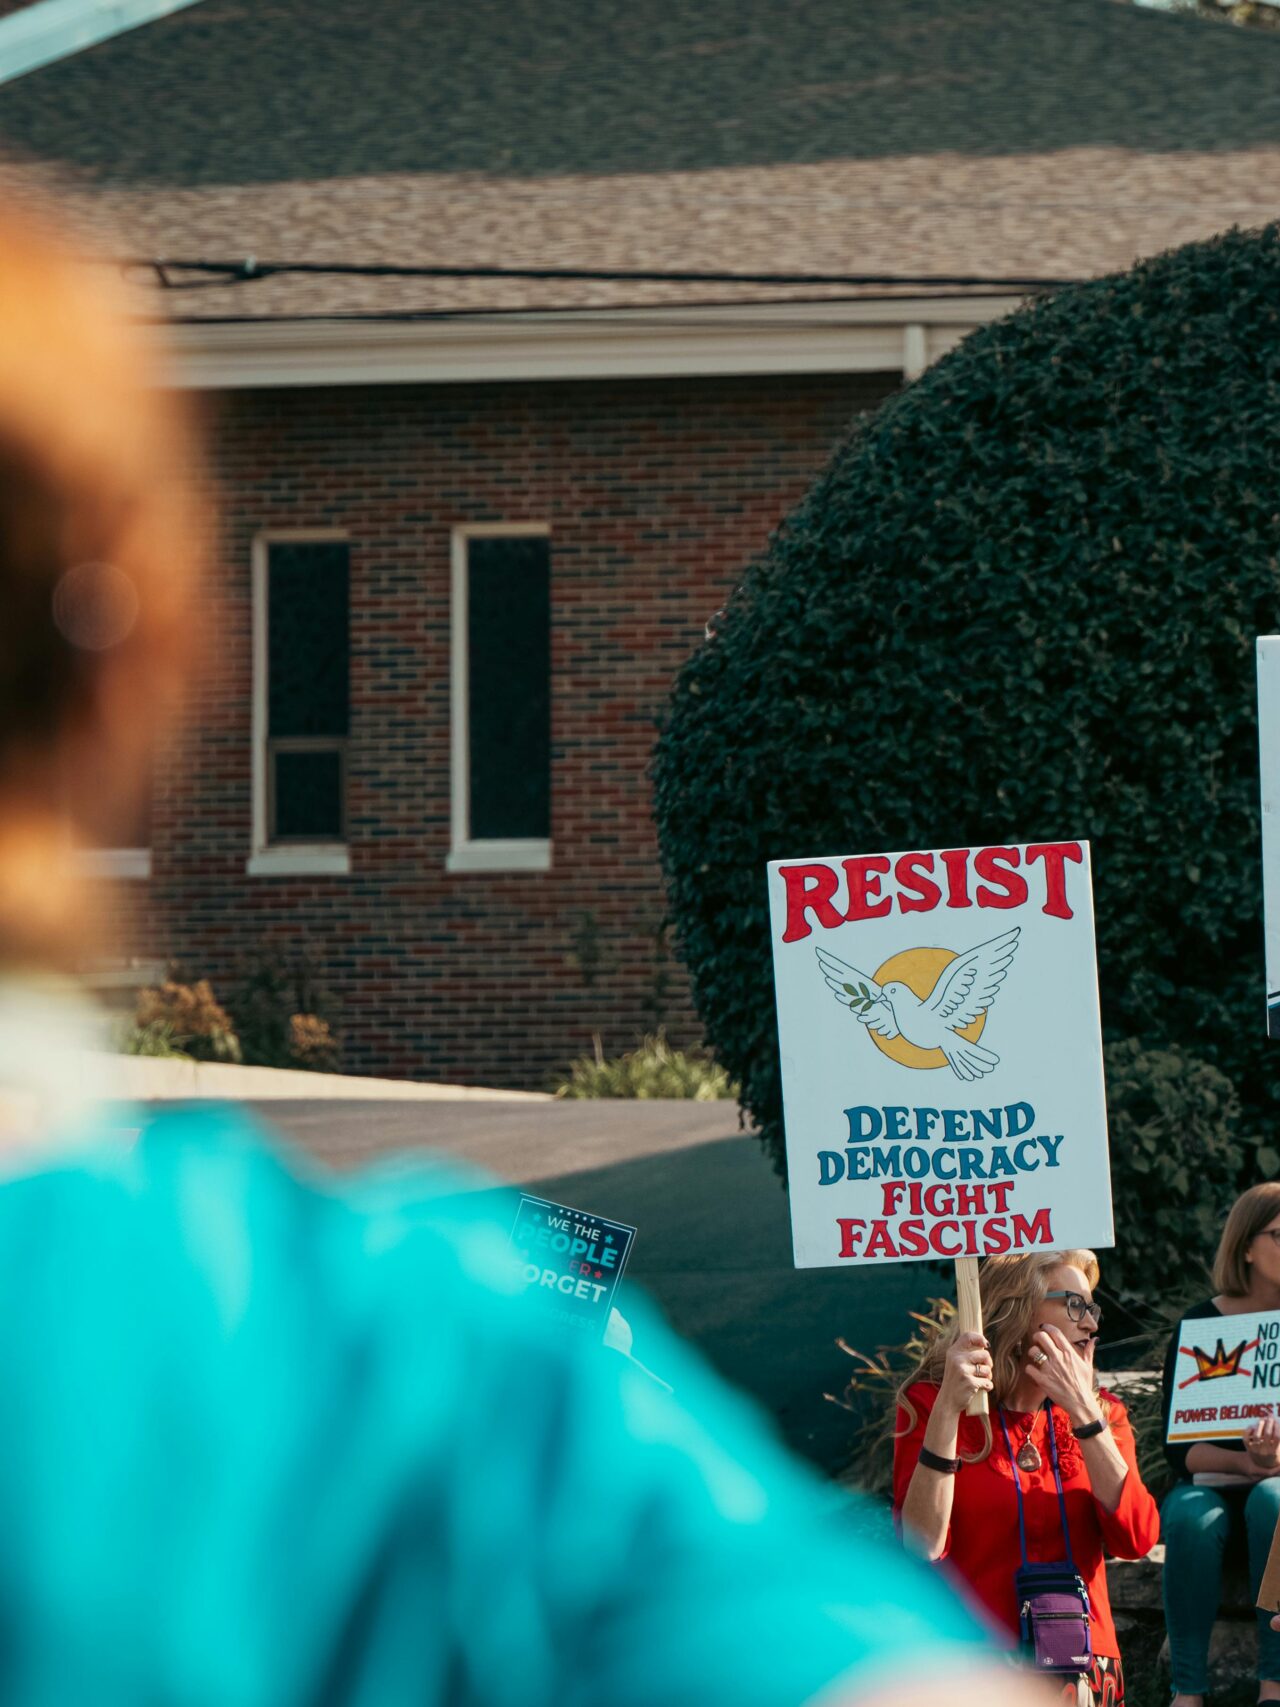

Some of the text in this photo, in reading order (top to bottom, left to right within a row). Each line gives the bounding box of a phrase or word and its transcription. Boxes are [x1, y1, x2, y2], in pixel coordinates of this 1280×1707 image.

[778, 842, 1082, 943] RESIST
[843, 1101, 1036, 1144] DEFEND
[817, 1135, 1065, 1185] DEMOCRACY
[881, 1181, 1015, 1217] FIGHT
[517, 1223, 618, 1269] PEOPLE
[547, 1215, 602, 1241] WE THE
[835, 1208, 1055, 1259] FASCISM
[513, 1261, 607, 1303] ORGET
[1254, 1342, 1278, 1361] NO
[1257, 1322, 1280, 1340] NO
[1174, 1407, 1218, 1424] POWER
[1220, 1403, 1274, 1421] BELONGS
